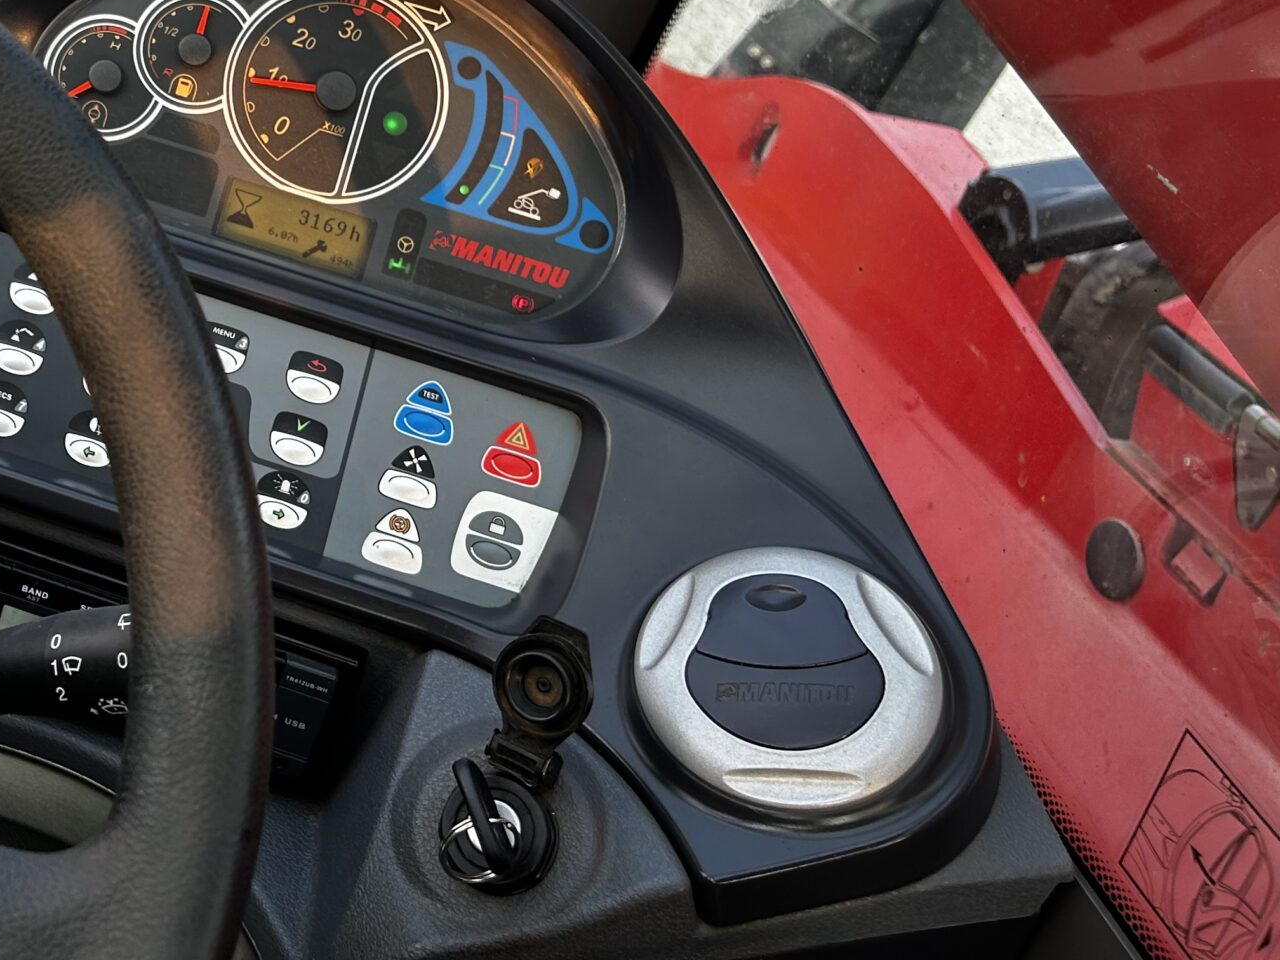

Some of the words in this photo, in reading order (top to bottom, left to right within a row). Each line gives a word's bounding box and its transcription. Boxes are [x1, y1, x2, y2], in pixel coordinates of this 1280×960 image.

[163, 26, 179, 38] 1/2
[338, 19, 362, 42] 30
[292, 28, 317, 50] 20
[274, 115, 291, 135] 0
[451, 235, 571, 289] MANITOU
[212, 326, 236, 340] MENU
[239, 338, 248, 349] 3
[421, 388, 441, 402] TEST
[18, 401, 27, 412] 7
[21, 584, 49, 601] BAND
[50, 634, 62, 650] 0
[51, 659, 59, 677] 1
[55, 686, 68, 702] 2
[737, 680, 854, 704] MANITOU
[284, 716, 306, 730] USB
